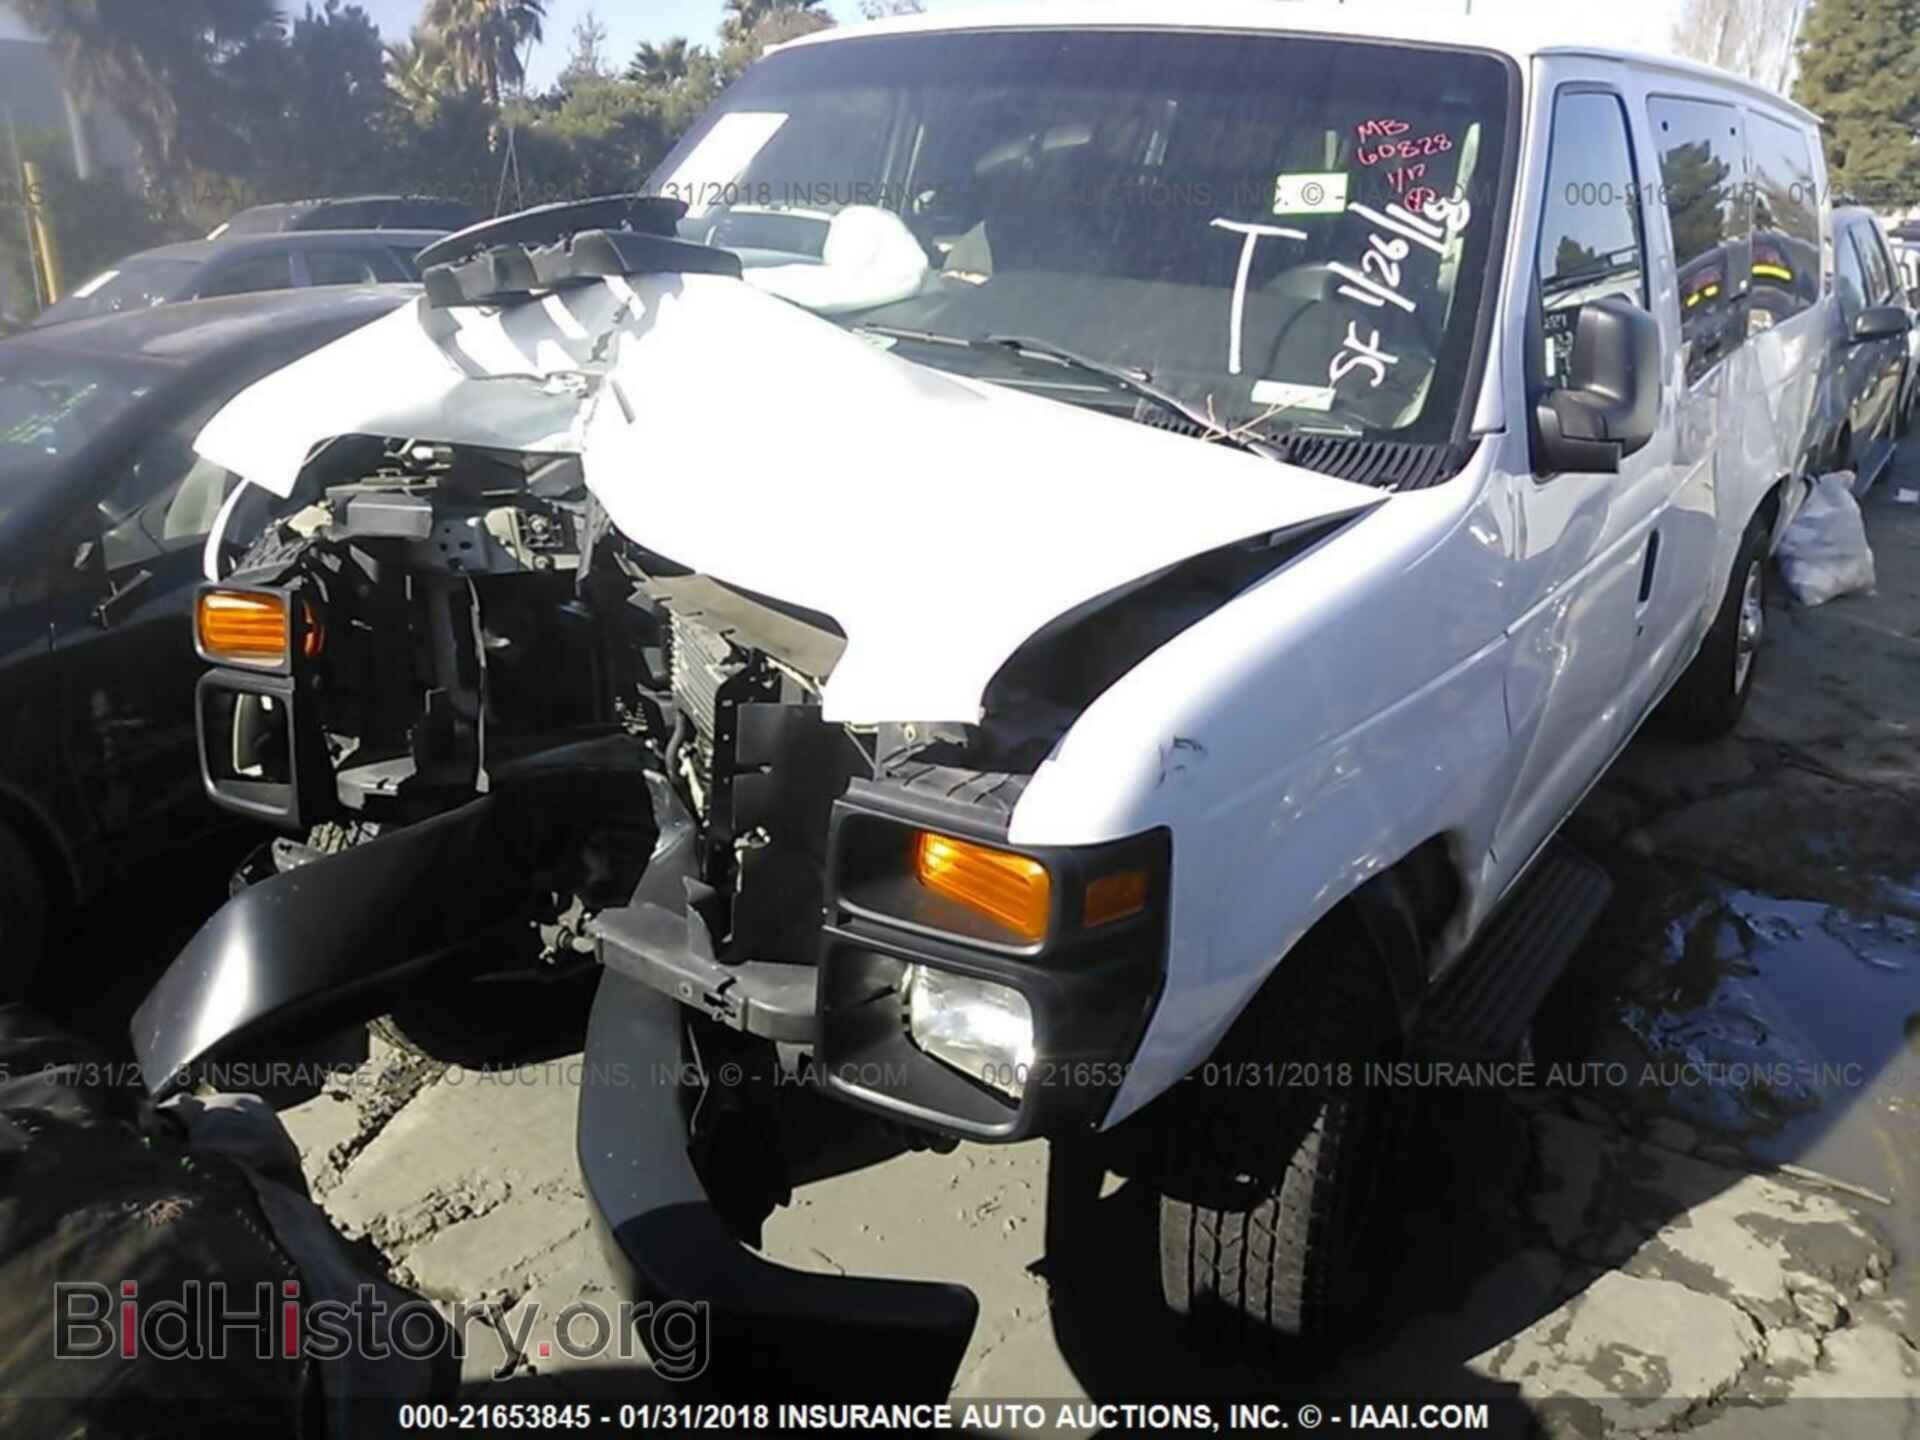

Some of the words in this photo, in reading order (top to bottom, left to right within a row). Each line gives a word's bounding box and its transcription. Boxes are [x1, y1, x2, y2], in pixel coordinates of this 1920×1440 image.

[1358, 120, 1410, 144] MB
[1358, 133, 1453, 166] 60828
[1328, 320, 1398, 387] SF
